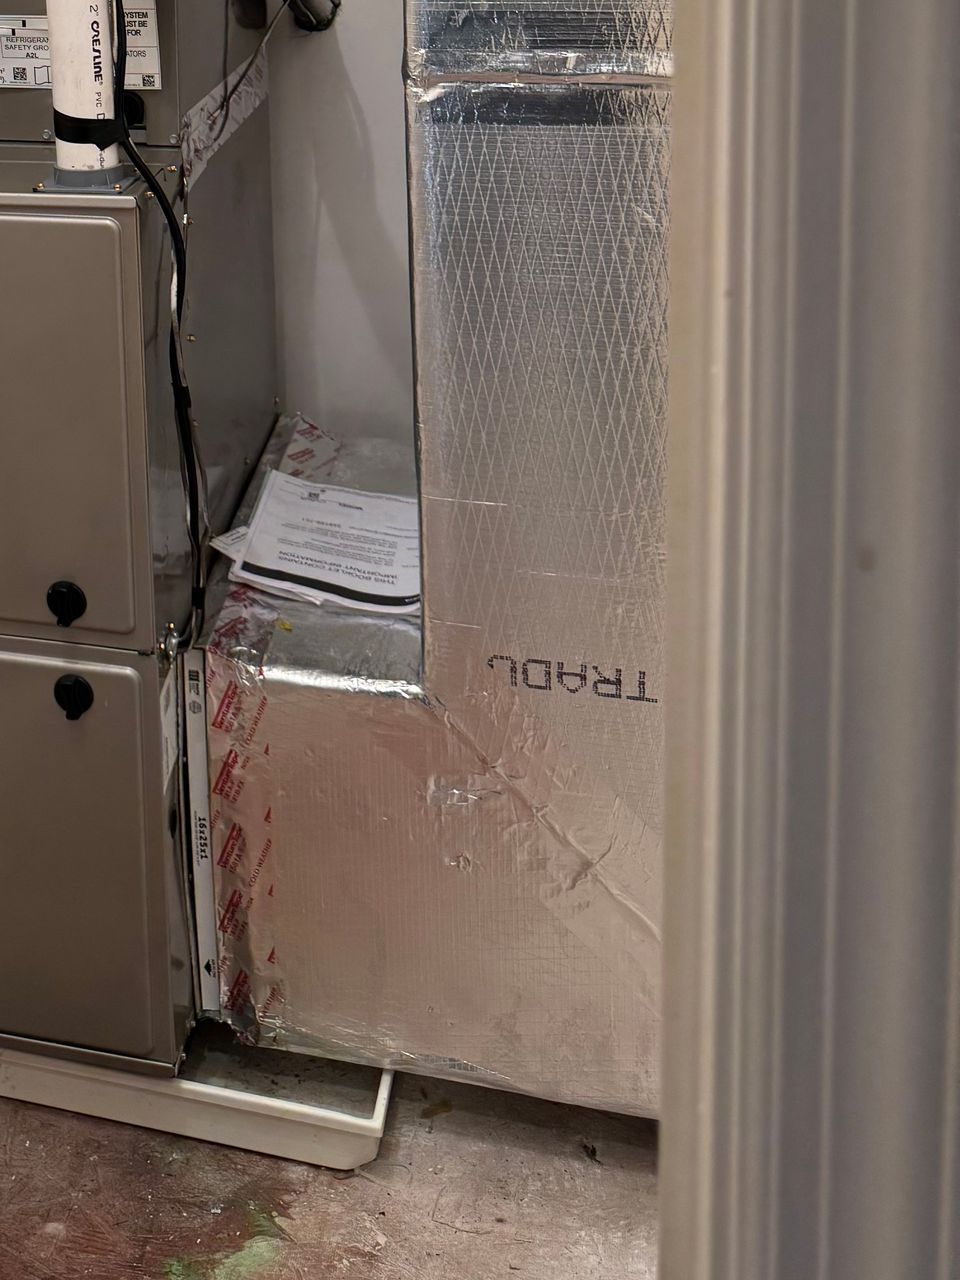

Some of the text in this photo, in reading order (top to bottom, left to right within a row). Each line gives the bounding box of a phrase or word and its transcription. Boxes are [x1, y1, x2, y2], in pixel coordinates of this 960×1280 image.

[277, 556, 396, 586] THIS BOOKLET CONTAINS
[278, 551, 398, 579] IMPORTANT INFORMATION
[198, 815, 208, 860] 16x25x1
